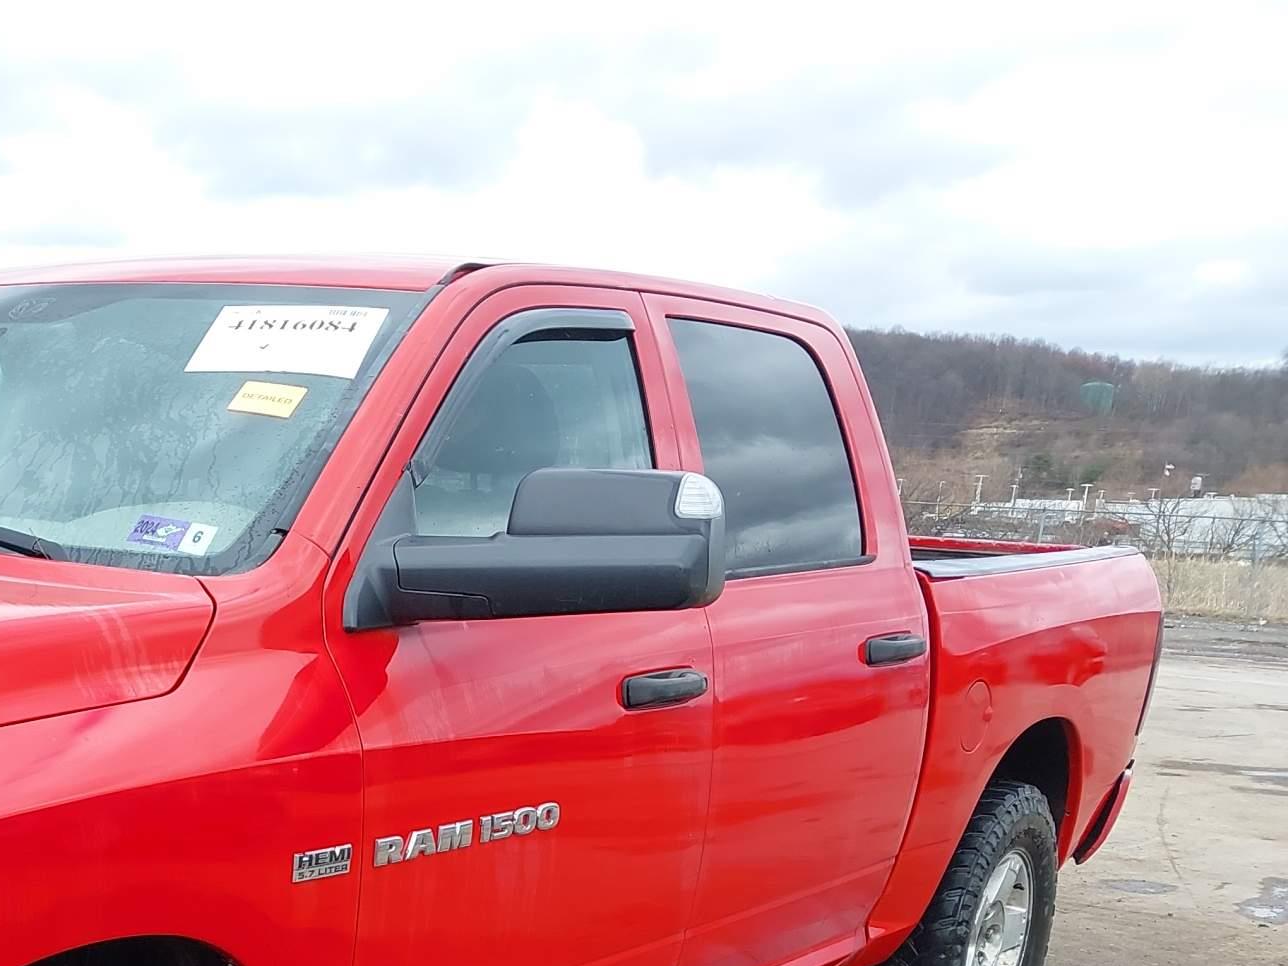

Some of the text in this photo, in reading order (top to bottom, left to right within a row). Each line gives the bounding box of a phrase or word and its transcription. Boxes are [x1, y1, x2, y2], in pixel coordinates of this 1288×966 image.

[228, 319, 358, 333] 41816084
[241, 392, 293, 405] DETAILED
[133, 519, 160, 535] 2024
[192, 530, 204, 544] 6
[374, 801, 562, 867] RAM 1500
[295, 843, 353, 871] HEMI
[296, 863, 349, 882] 5.7 LITER
